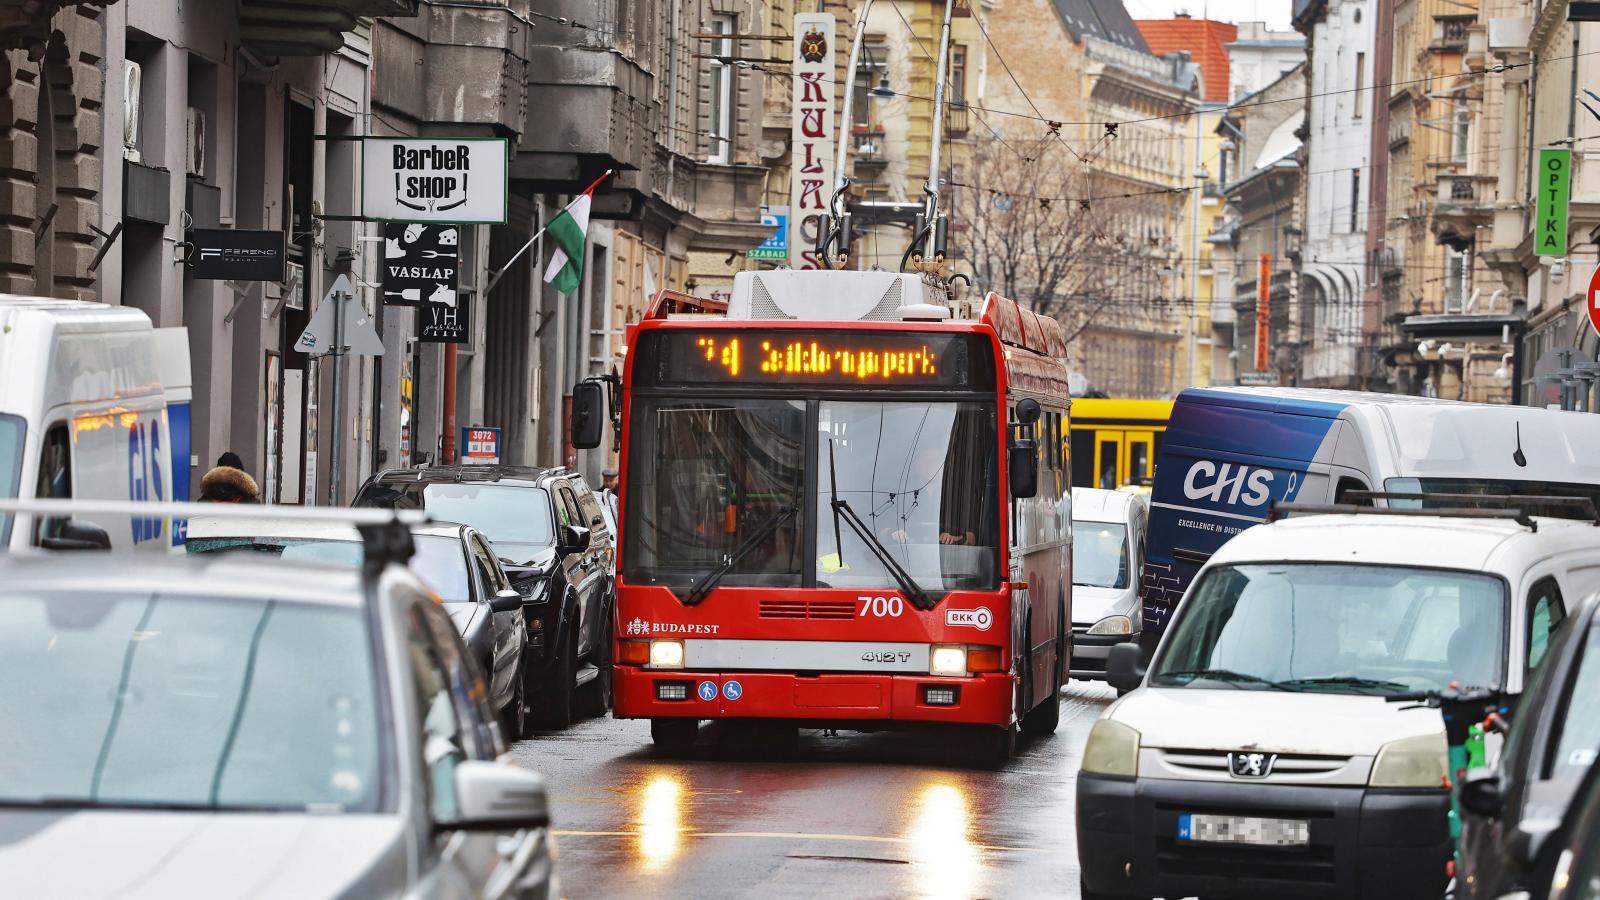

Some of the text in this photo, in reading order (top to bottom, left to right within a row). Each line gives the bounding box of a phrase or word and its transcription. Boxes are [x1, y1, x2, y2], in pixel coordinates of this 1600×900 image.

[393, 144, 470, 170] BarbeR
[406, 176, 457, 198] SHOP
[1544, 158, 1562, 247] OPTIKA
[225, 248, 277, 256] FERENCI
[748, 249, 786, 258] SZABAD
[389, 266, 454, 279] VASLAP
[473, 430, 492, 440] 3072
[129, 418, 163, 545] GLS
[1183, 460, 1275, 507] CHS
[1177, 518, 1215, 532] EXCELLENCE
[1215, 524, 1223, 533] IN
[857, 596, 904, 618] 700
[952, 613, 973, 622] BKK
[652, 623, 720, 634] BUDAPEST
[862, 651, 911, 663] 412 T
